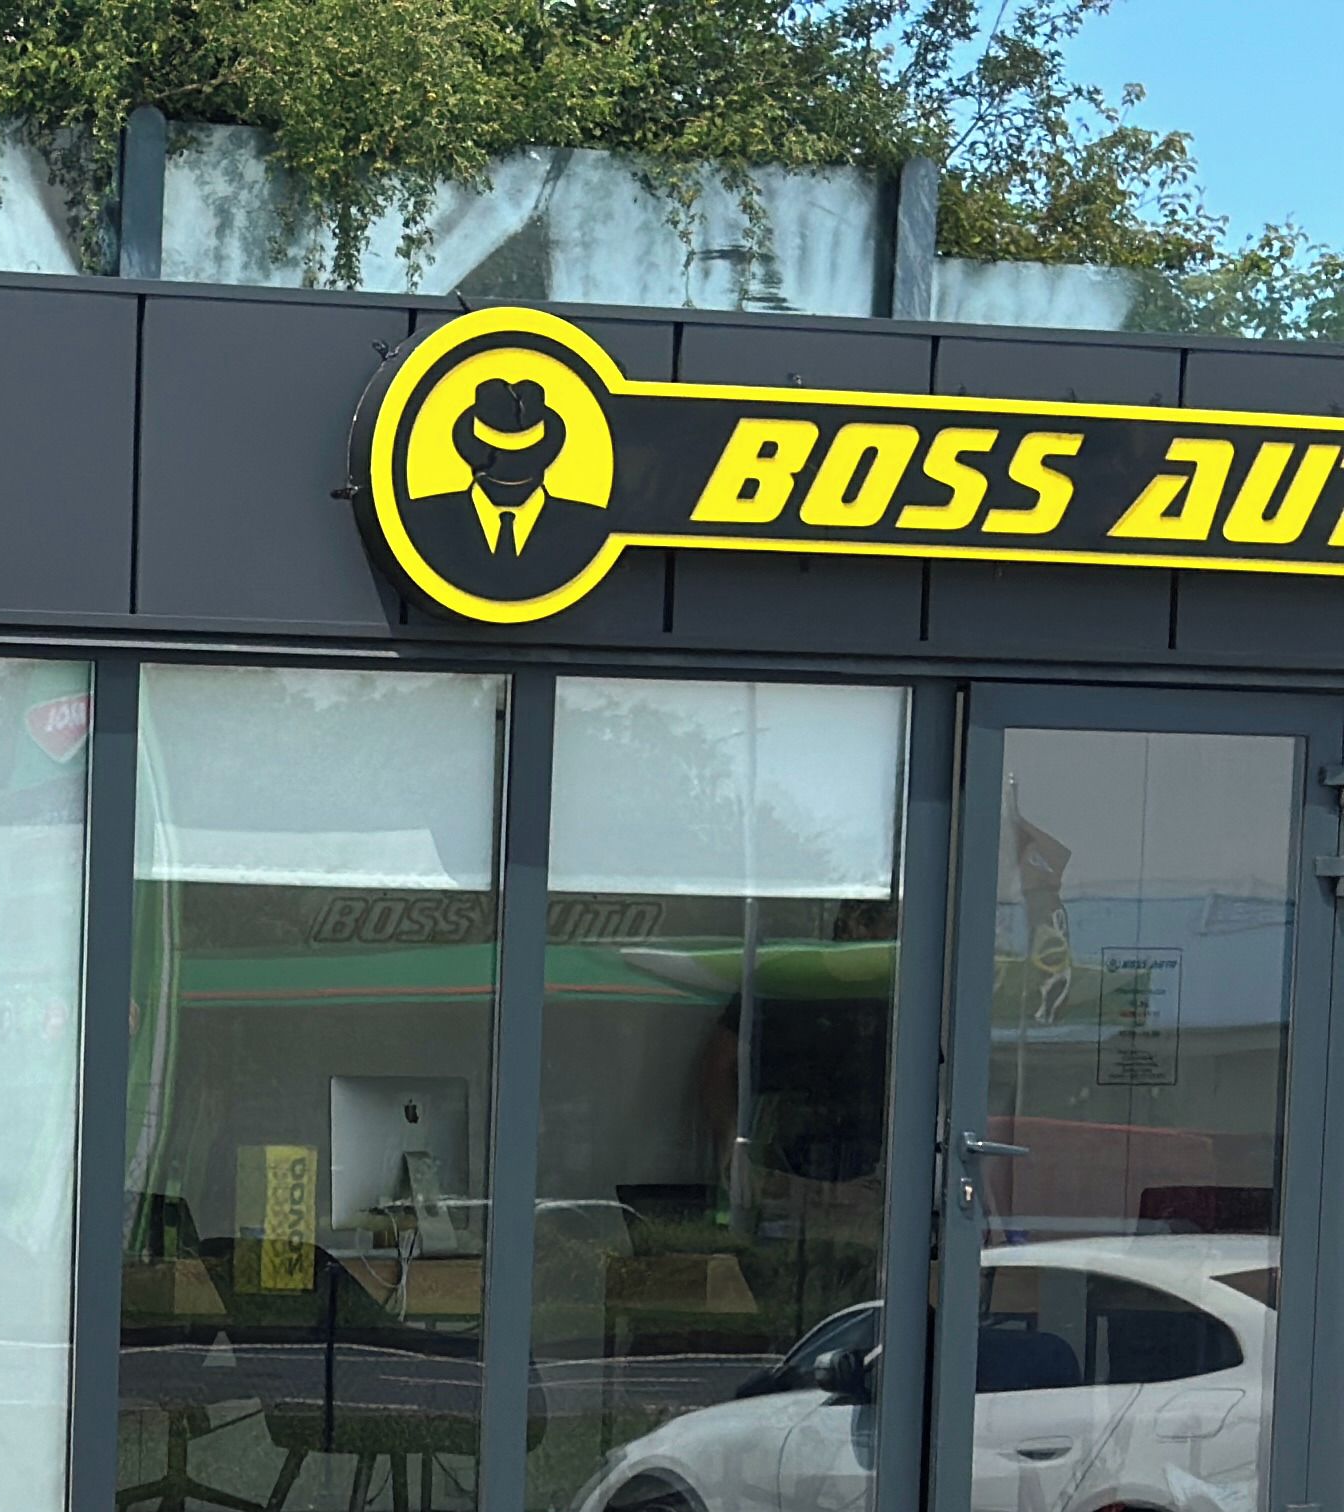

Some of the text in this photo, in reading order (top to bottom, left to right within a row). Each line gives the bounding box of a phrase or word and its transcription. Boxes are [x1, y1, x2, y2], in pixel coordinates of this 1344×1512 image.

[690, 417, 1344, 547] BOSS AU
[312, 898, 664, 944] BOSS UTO
